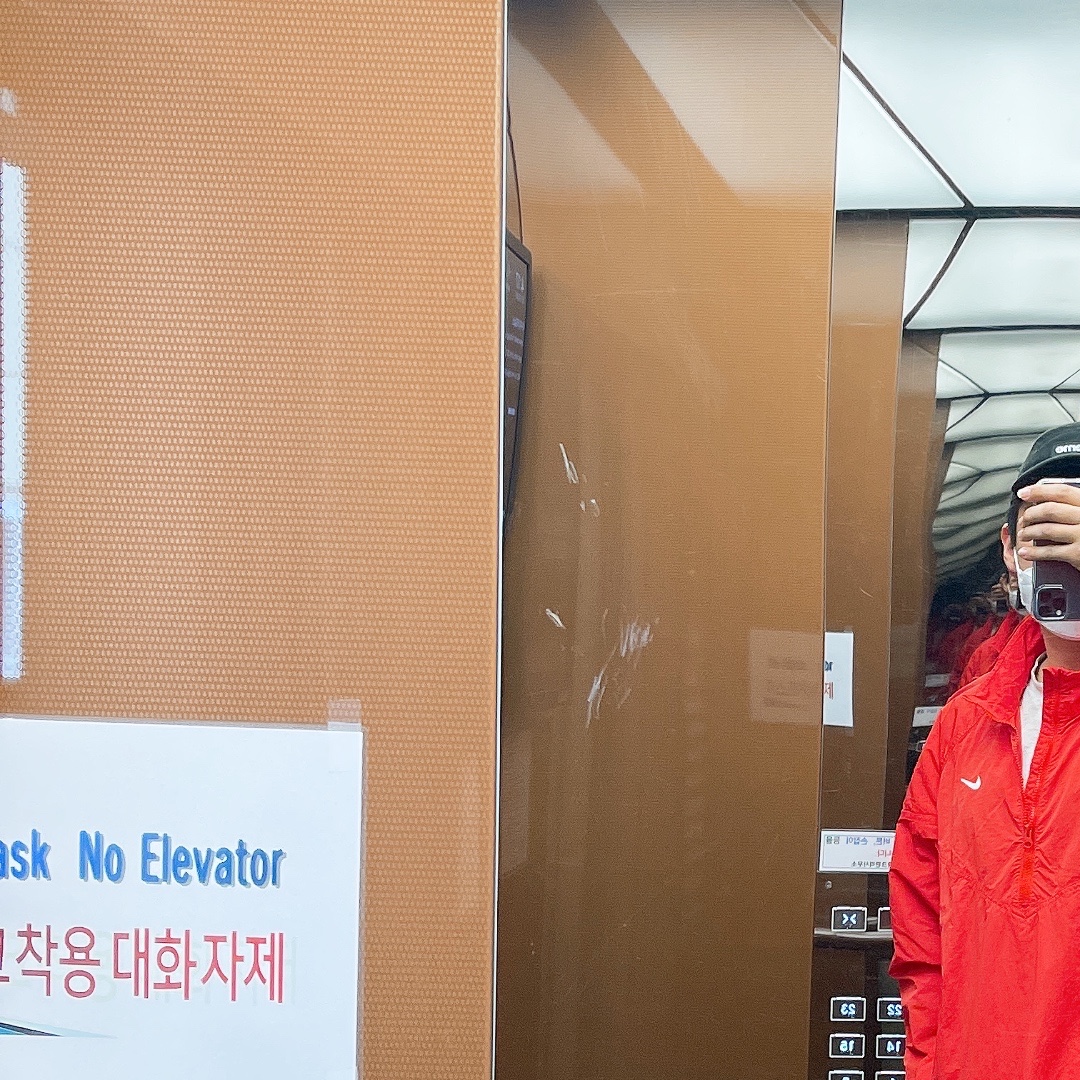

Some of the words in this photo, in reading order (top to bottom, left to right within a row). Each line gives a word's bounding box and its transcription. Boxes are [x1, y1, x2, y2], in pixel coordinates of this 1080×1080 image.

[79, 830, 125, 883] No
[141, 832, 287, 888] Elevator
[112, 927, 285, 1003] 대화자제
